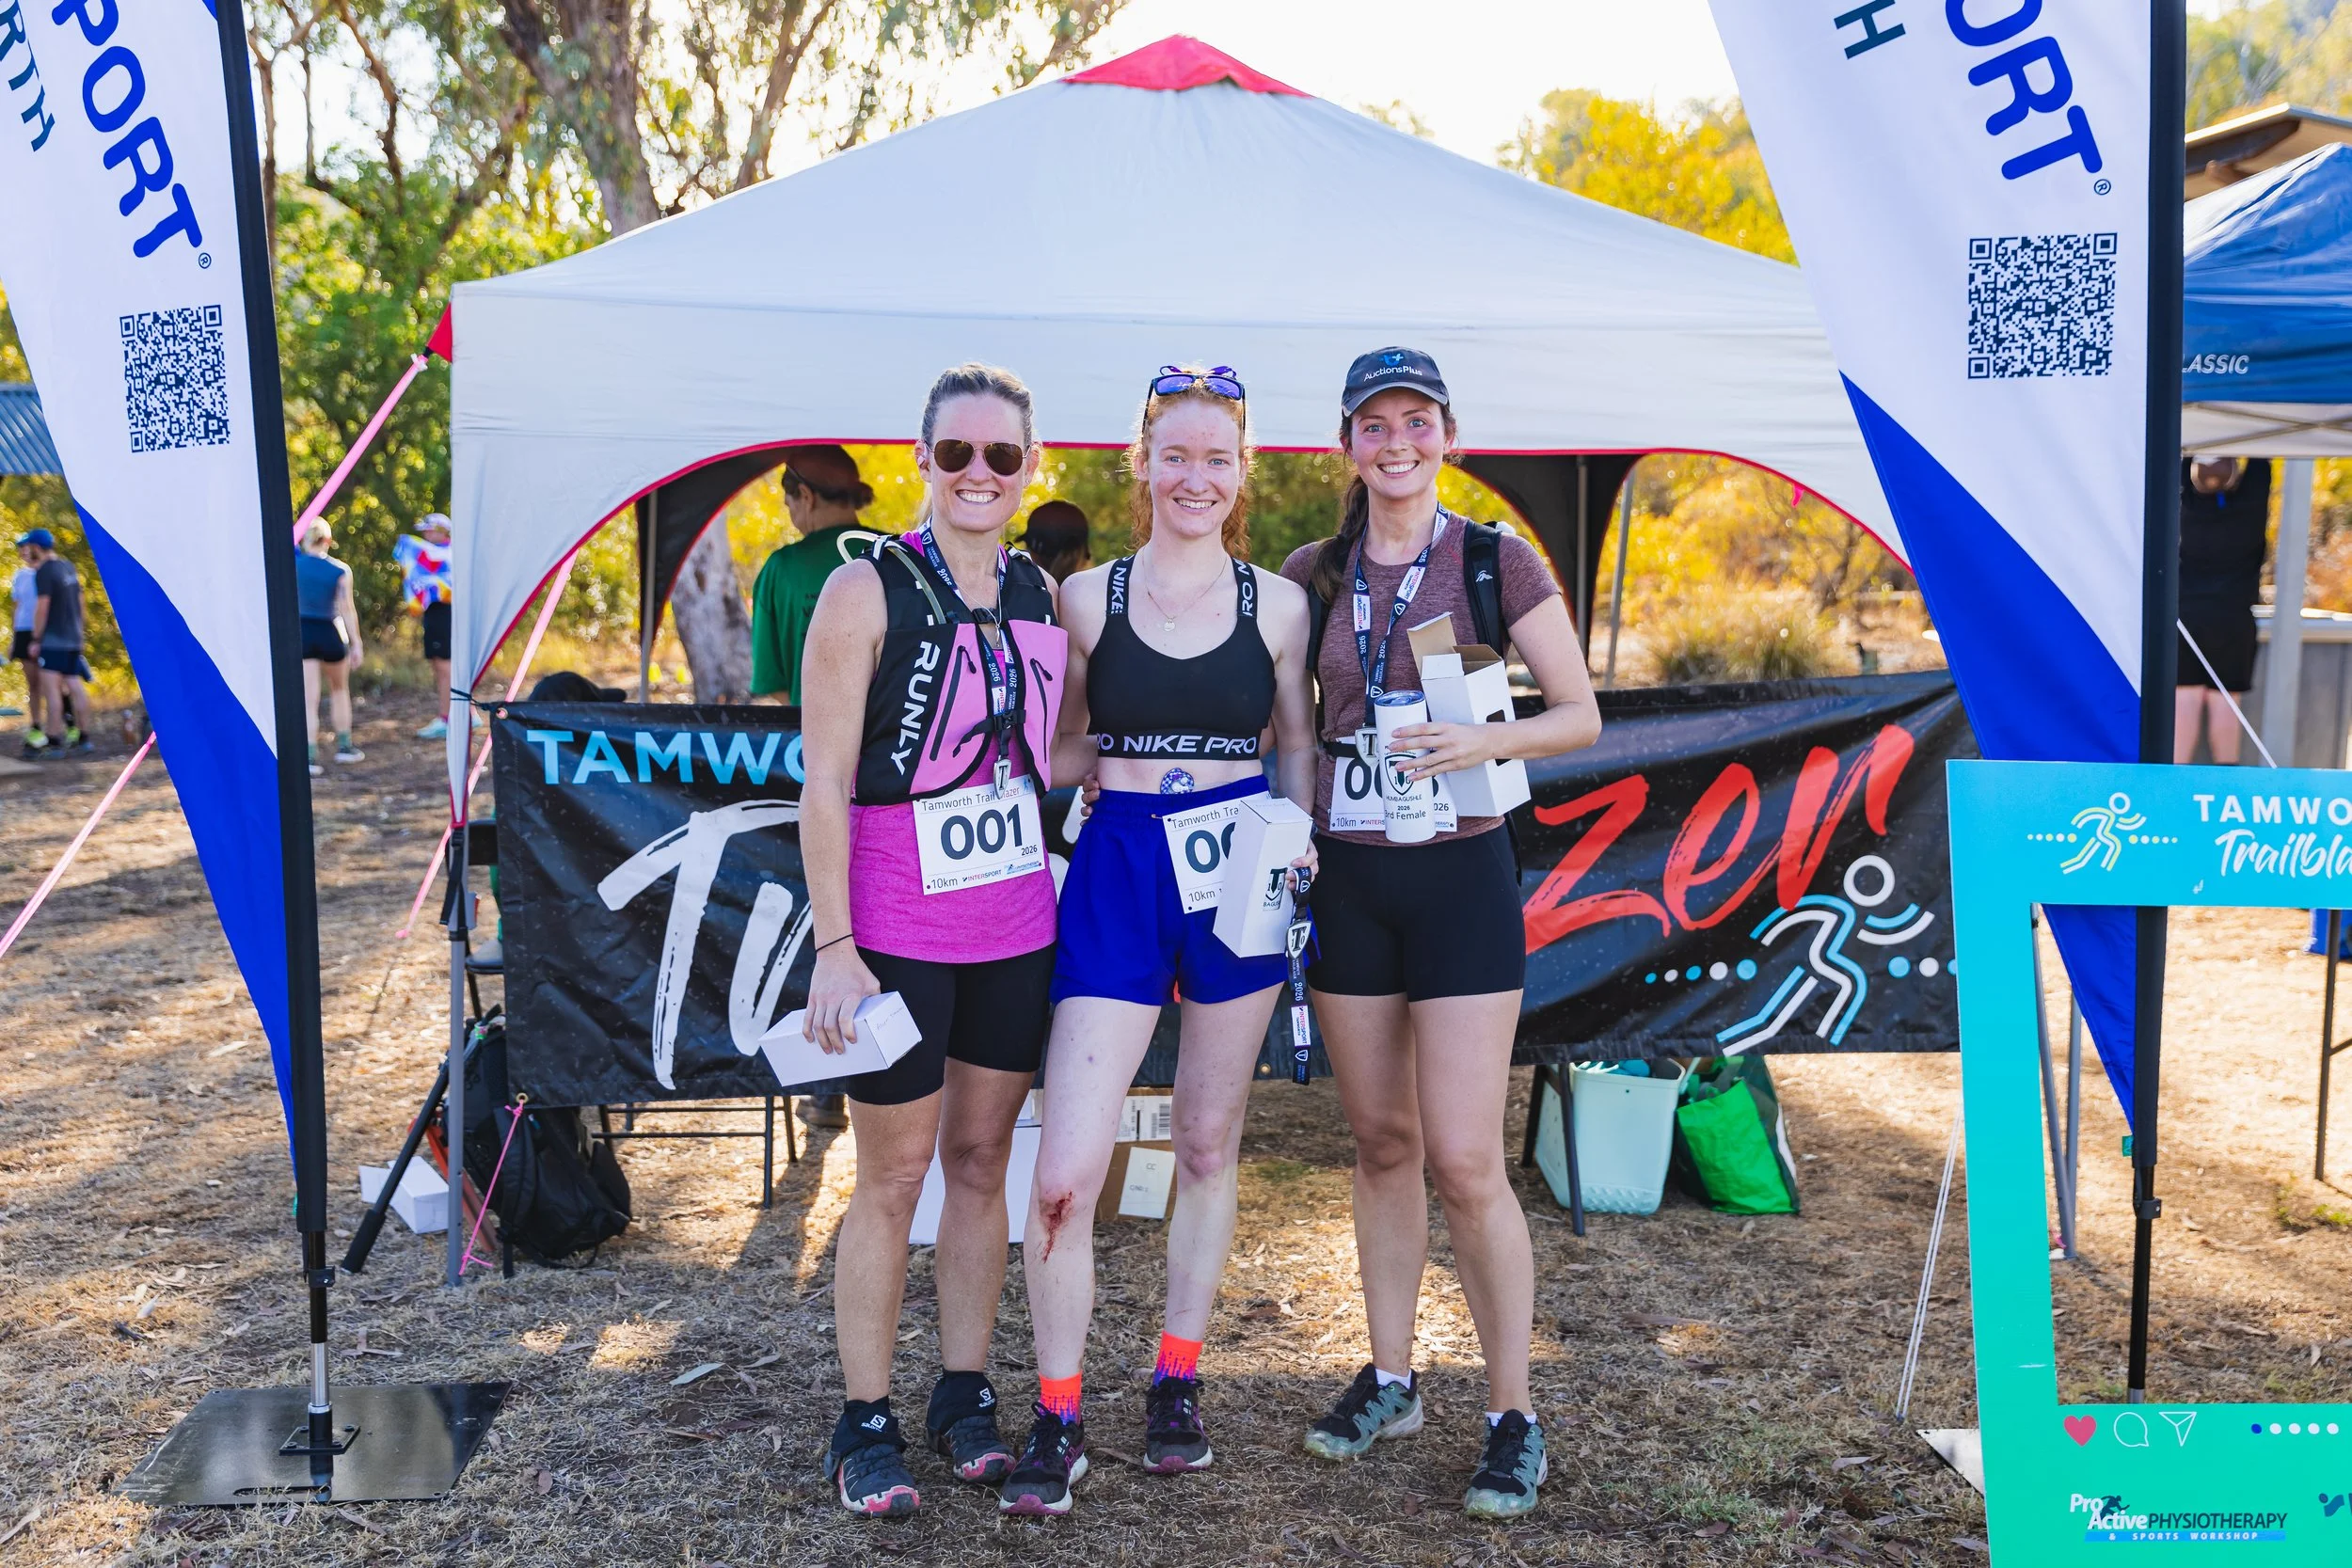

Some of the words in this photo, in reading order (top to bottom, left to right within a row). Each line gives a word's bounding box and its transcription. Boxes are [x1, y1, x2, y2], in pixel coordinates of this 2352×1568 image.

[1363, 365, 1423, 382] AuctionsPlus
[1111, 566, 1128, 614] NIKE
[988, 662, 1001, 682] 2026
[890, 641, 941, 776] RUNLY
[1122, 735, 1203, 752] NIKE
[1203, 736, 1257, 754] PRO
[921, 795, 973, 812] Tamworth
[2192, 794, 2352, 826] TAMWO
[1172, 810, 1221, 829] Tamworth
[1336, 816, 1357, 828] 10km
[1396, 810, 1426, 820] Female
[940, 803, 1023, 861] 001
[1021, 844, 1038, 857] 2026
[930, 877, 959, 890] 10km
[967, 869, 1002, 881] INTERSPORT
[1188, 887, 1216, 903] 10km
[1295, 982, 1304, 1002] 2026
[2070, 1493, 2104, 1513] Pro
[2087, 1509, 2148, 1530] Active
[2148, 1513, 2288, 1529] PHYSIOTHERAPY
[2132, 1532, 2180, 1541] SPORTS
[2190, 1531, 2259, 1541] WORKSHOP
